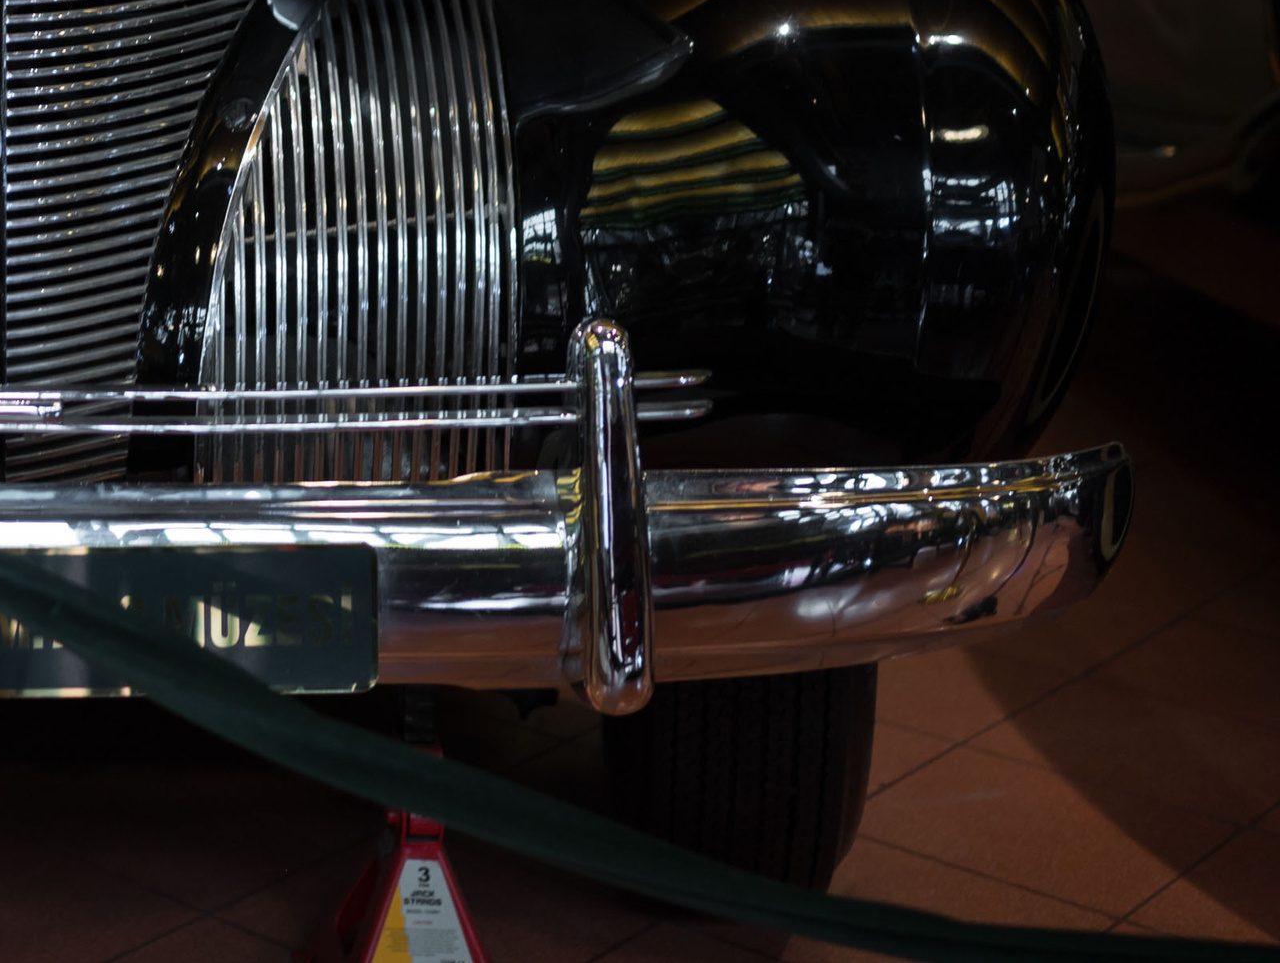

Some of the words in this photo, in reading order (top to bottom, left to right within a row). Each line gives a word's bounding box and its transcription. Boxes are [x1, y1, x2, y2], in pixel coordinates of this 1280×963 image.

[418, 867, 431, 883] 3
[410, 889, 435, 897] JACK
[403, 897, 442, 906] STANDS
